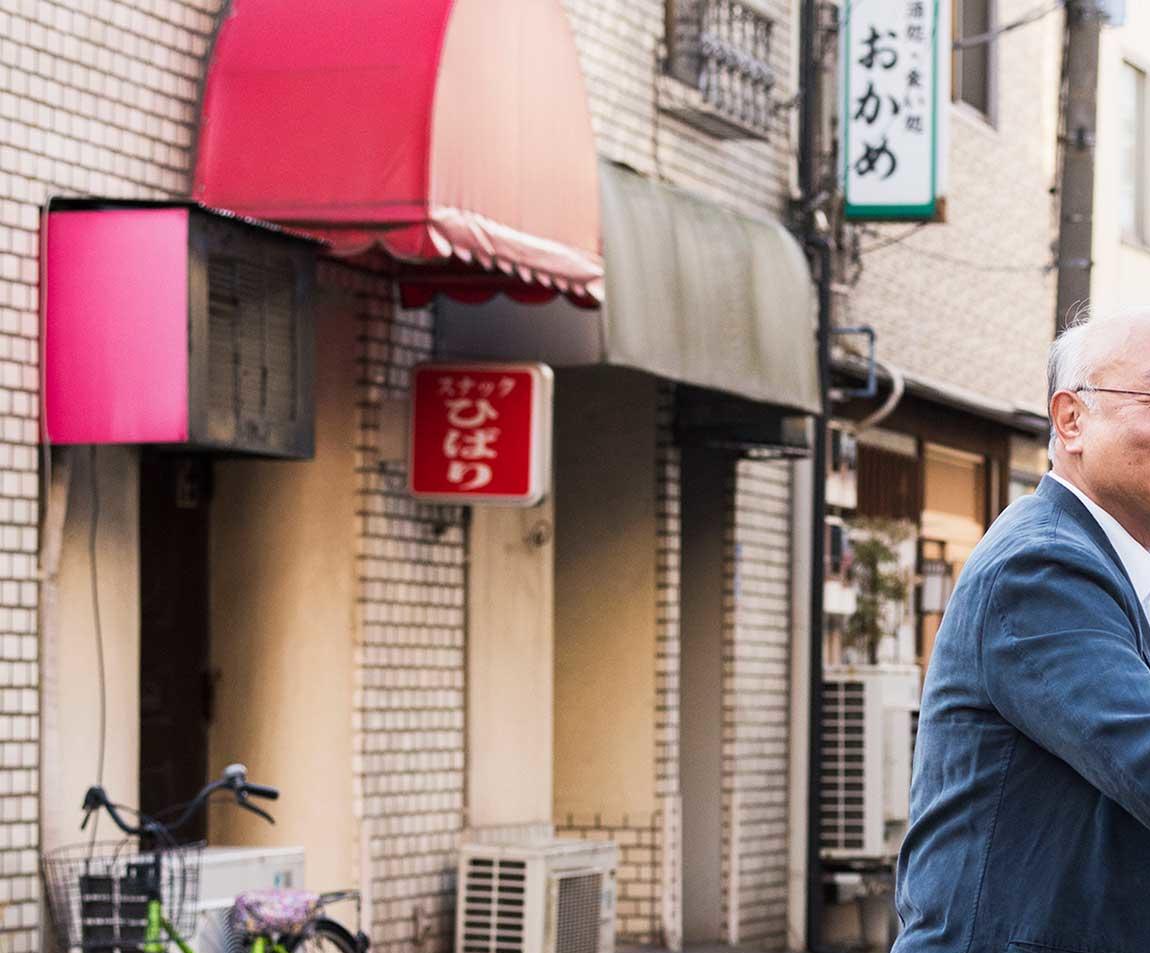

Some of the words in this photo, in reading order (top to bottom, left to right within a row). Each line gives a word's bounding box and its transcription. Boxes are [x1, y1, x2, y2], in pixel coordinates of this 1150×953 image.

[854, 24, 899, 181] おかめ
[438, 376, 516, 398] スナック
[443, 399, 501, 491] ひばり
